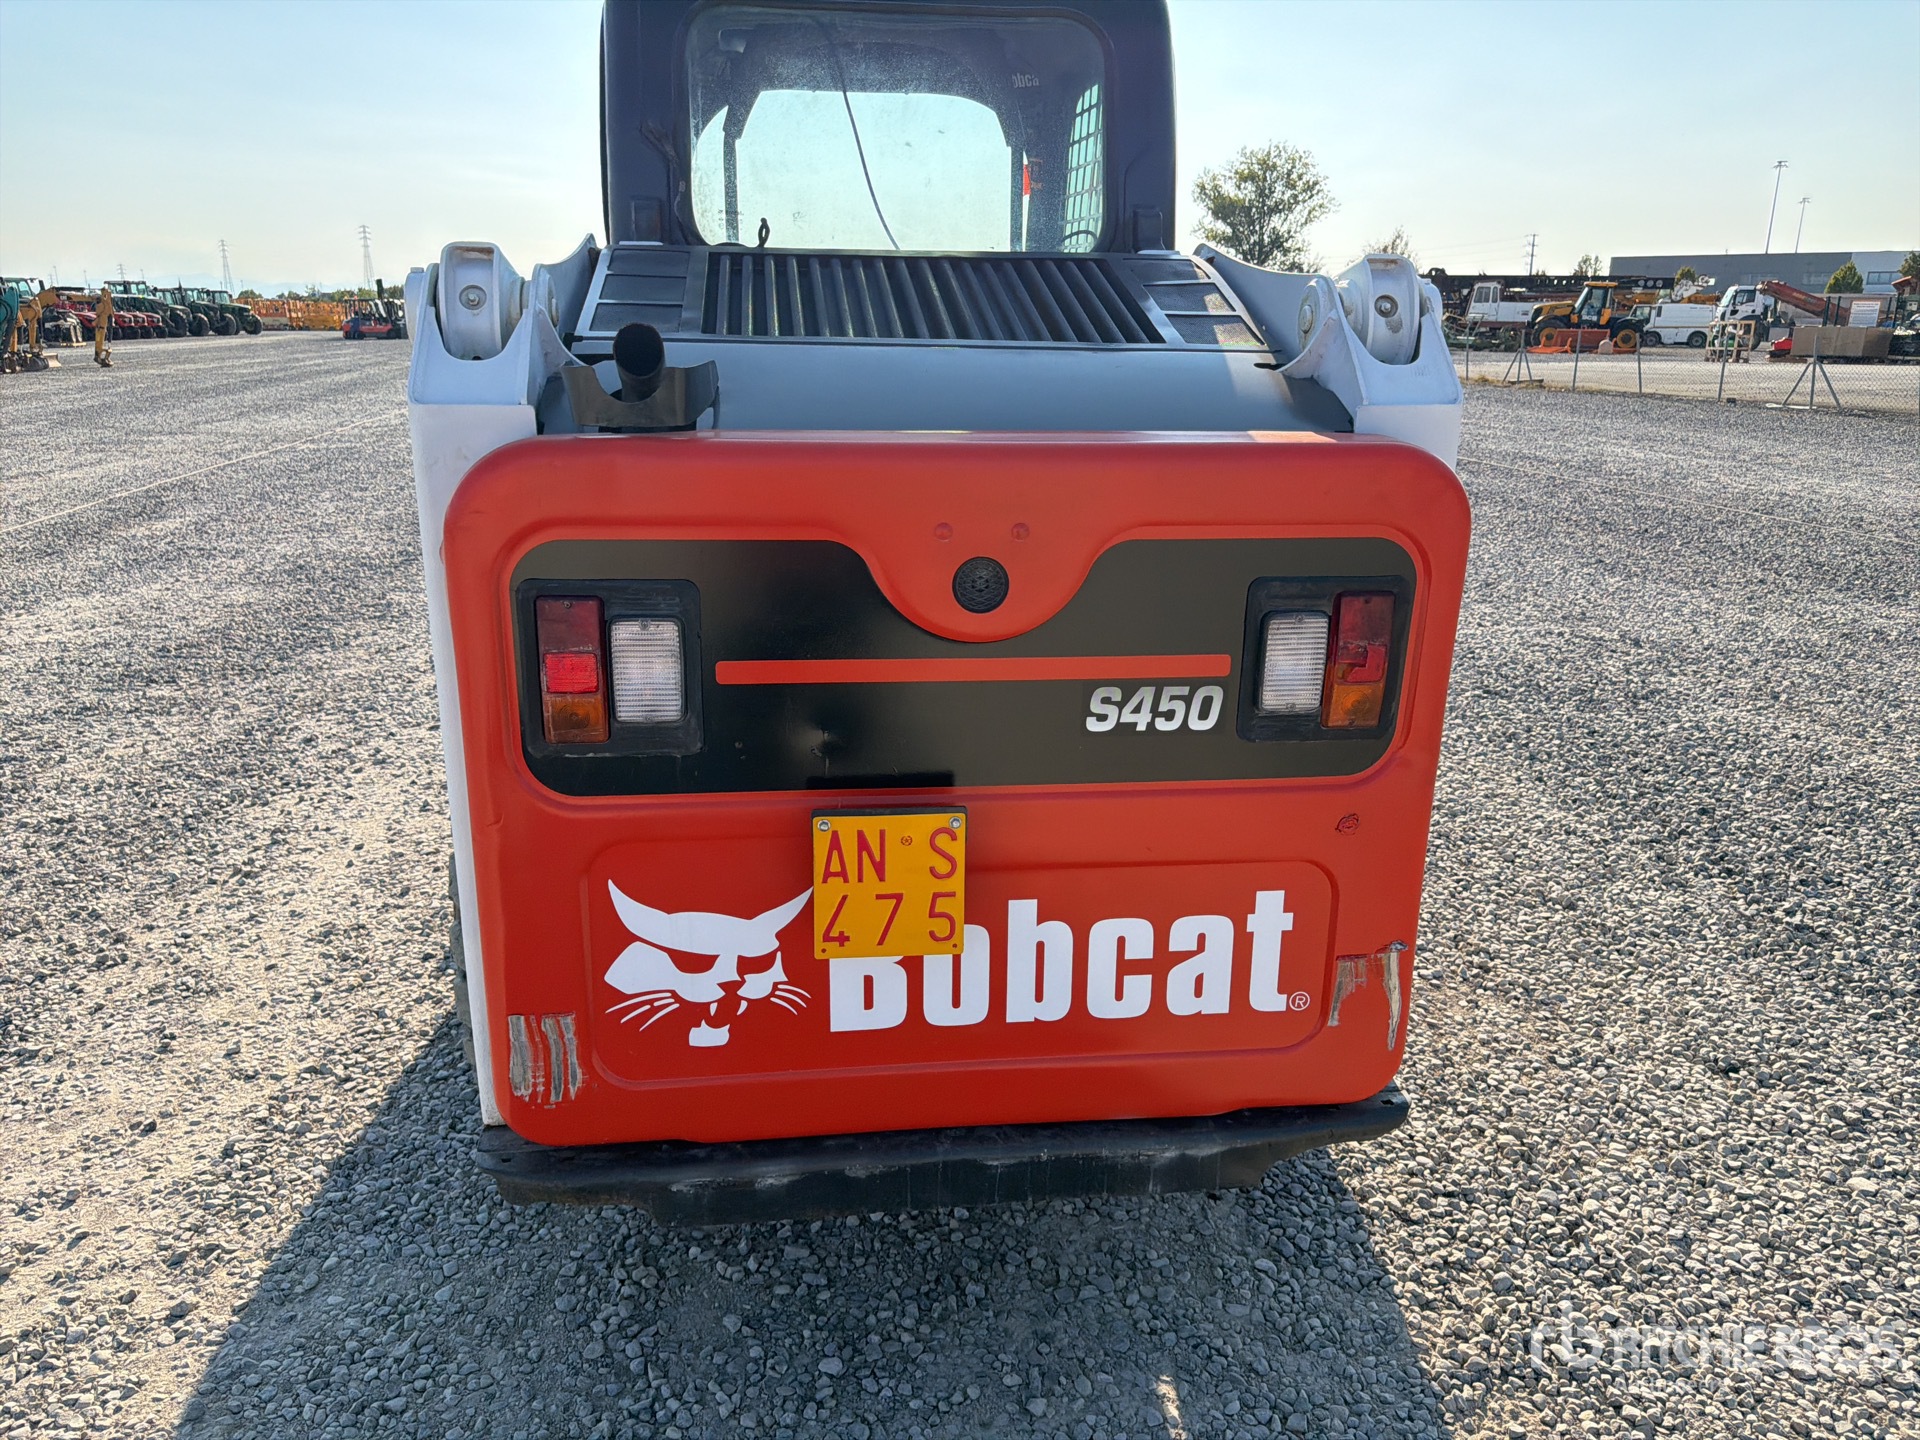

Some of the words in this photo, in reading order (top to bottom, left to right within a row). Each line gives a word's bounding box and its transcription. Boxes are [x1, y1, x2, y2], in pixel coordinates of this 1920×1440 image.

[1085, 685, 1224, 733] S450
[821, 829, 887, 884] AN
[928, 826, 958, 880] S
